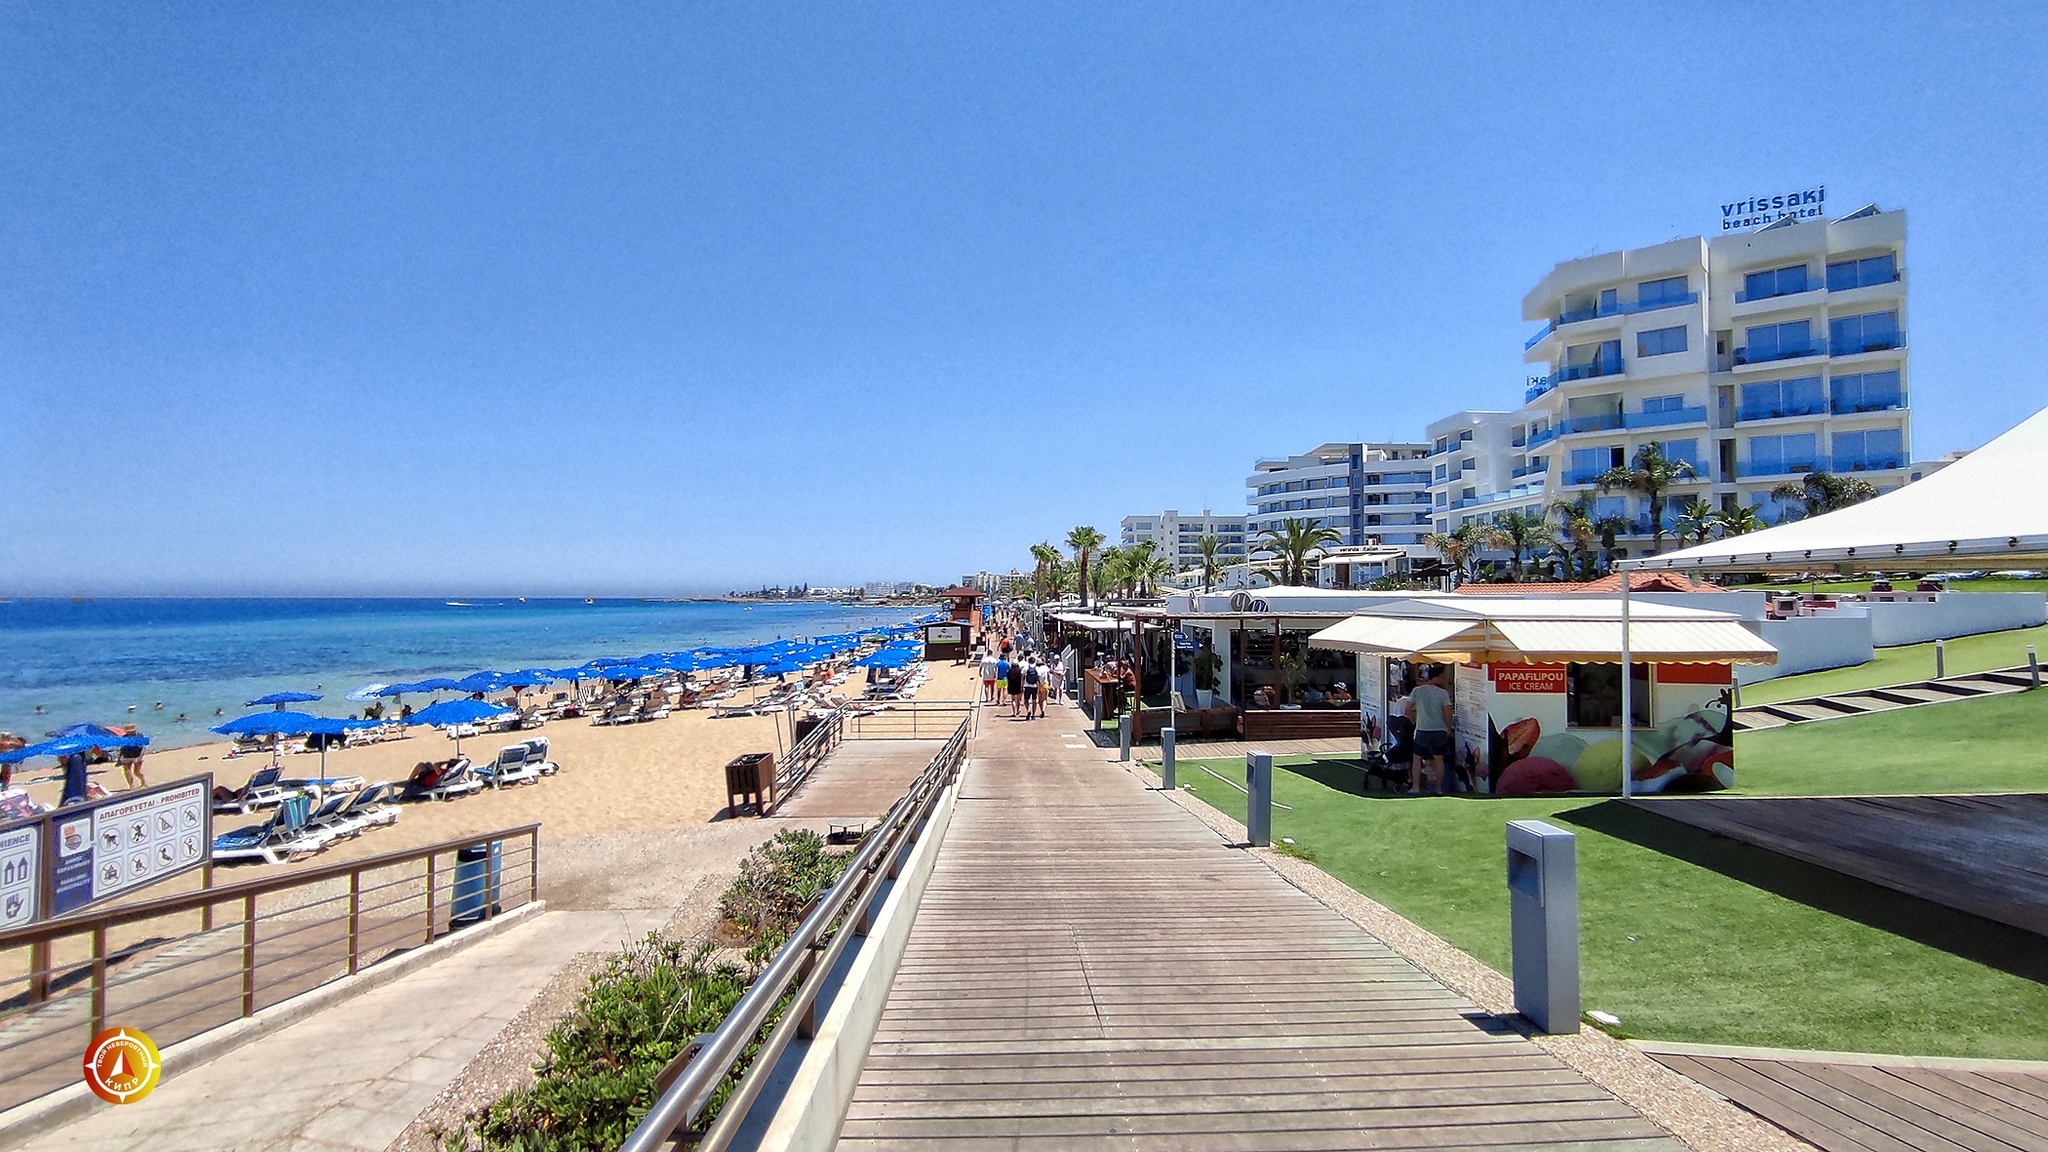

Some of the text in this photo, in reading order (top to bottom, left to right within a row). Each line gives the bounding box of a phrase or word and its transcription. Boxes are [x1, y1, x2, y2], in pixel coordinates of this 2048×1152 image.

[1721, 185, 1825, 216] vrissaki
[1723, 213, 1771, 230] beach
[1509, 682, 1553, 690] ICE CREAM
[160, 788, 200, 803] PROHIBITED
